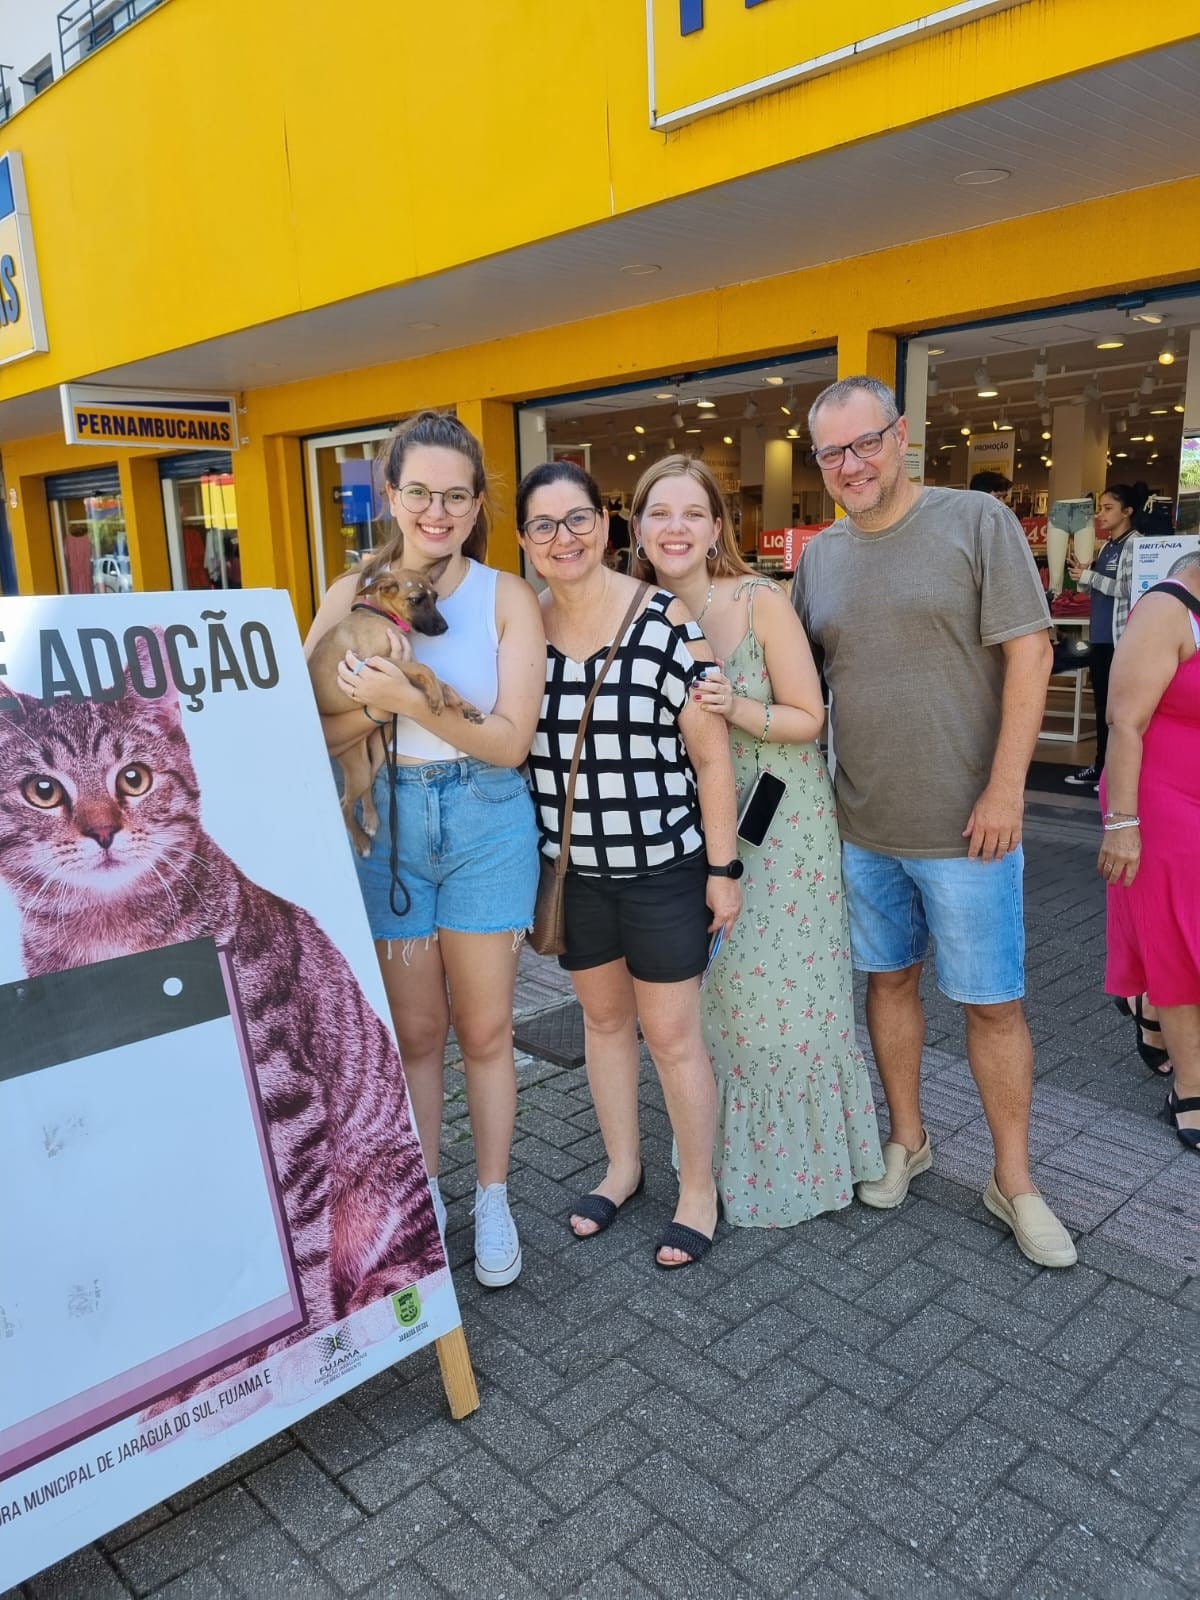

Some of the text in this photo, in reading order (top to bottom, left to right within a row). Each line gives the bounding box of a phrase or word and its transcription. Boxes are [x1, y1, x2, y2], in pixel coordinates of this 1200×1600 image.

[0, 254, 20, 328] S
[77, 413, 230, 441] PERNAMBUCANAS
[784, 529, 793, 569] LIQUIDA
[39, 609, 279, 712] ADOÇÃO
[319, 1348, 360, 1376] FUJAMA
[23, 1463, 95, 1513] MUNICIPAL
[97, 1450, 115, 1473] DE
[118, 1419, 173, 1464] JARAGUÁ
[173, 1412, 191, 1433] DO
[218, 1374, 263, 1409] FUJAMA
[263, 1368, 273, 1385] E
